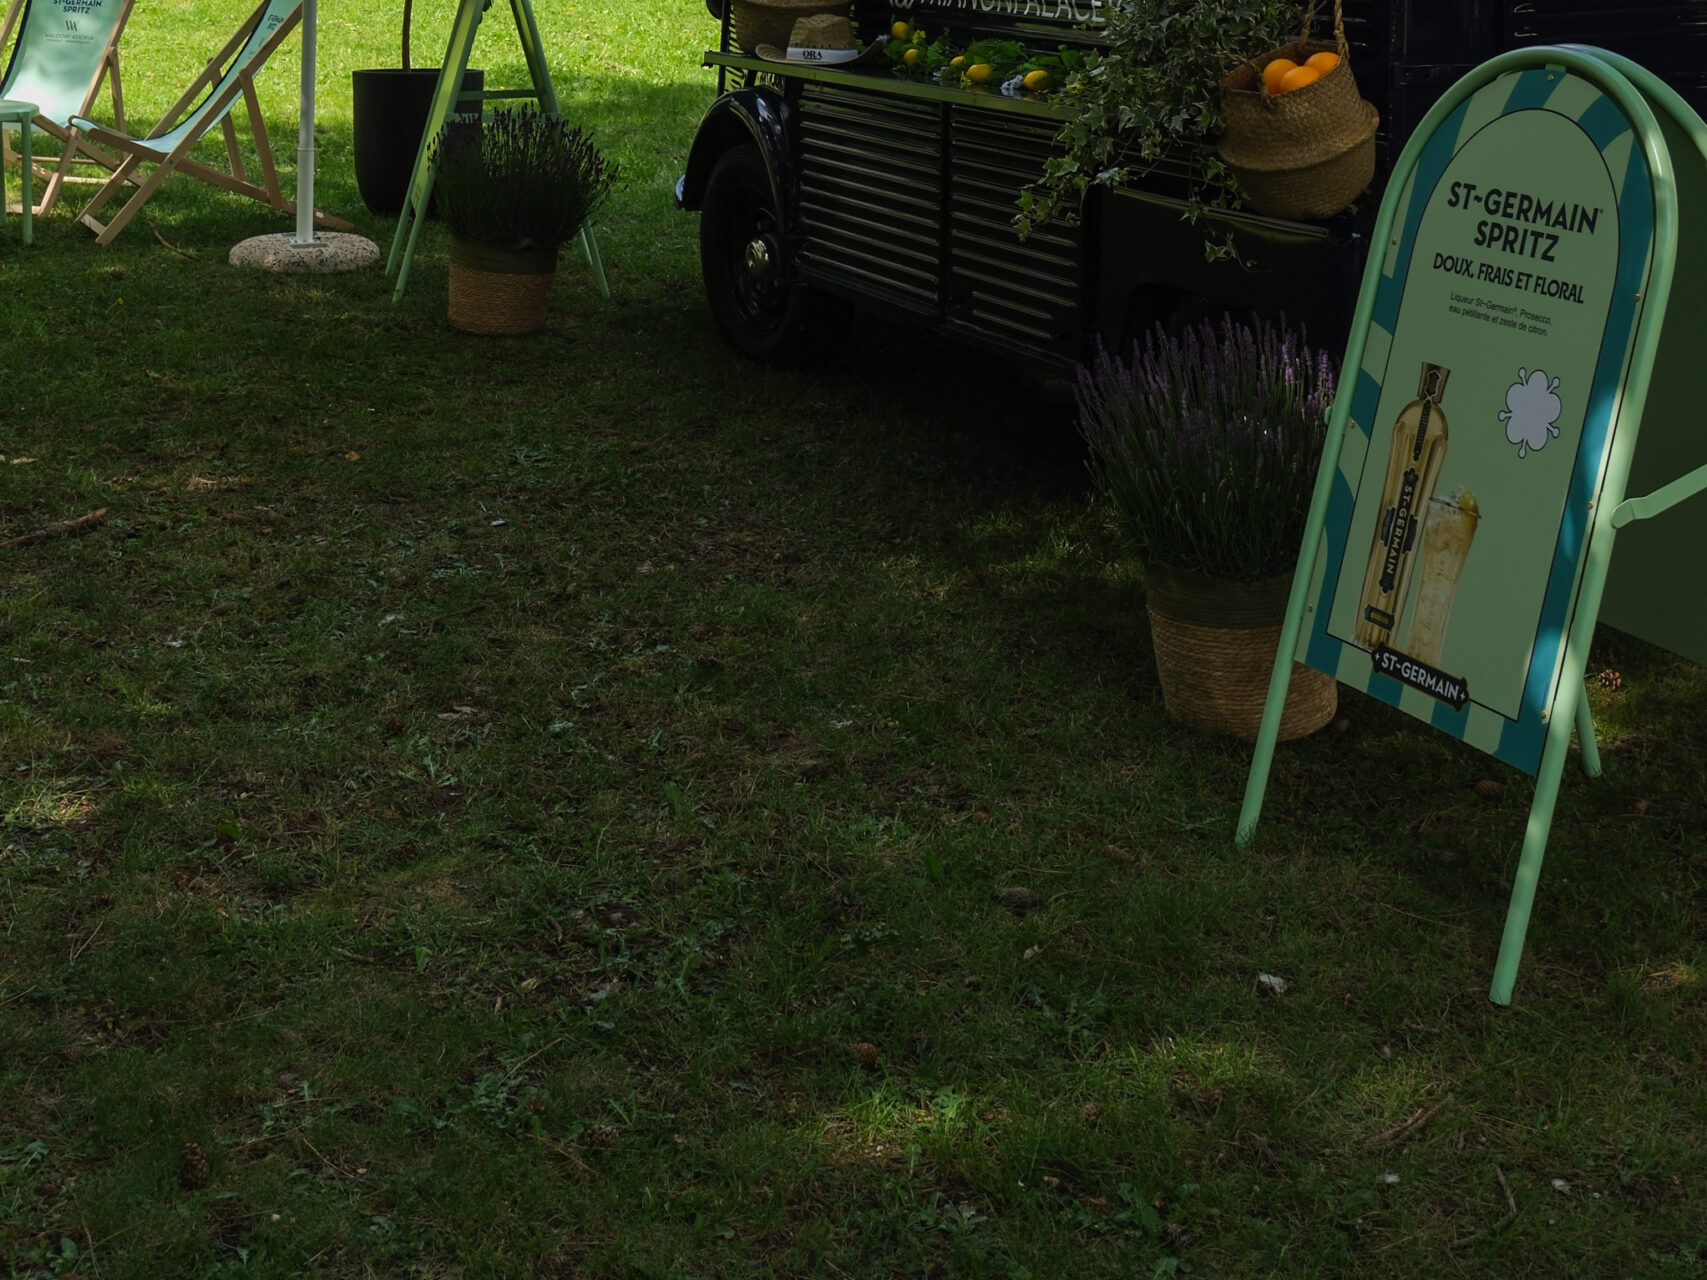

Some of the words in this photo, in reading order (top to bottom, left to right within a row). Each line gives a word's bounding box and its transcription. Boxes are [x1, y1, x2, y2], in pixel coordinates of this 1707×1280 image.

[63, 6, 91, 14] SPRITZ
[802, 49, 823, 59] ORA
[1473, 220, 1560, 262] SPRITZ
[1450, 291, 1474, 304] Liqueur
[1477, 263, 1514, 286] FRAIS
[1515, 271, 1533, 291] ET
[1533, 277, 1584, 304] FLORAL
[1491, 315, 1499, 323] et
[1499, 317, 1517, 329] zeste
[1518, 322, 1527, 331] de
[1386, 484, 1412, 575] ST-GERMAIN
[1381, 652, 1459, 701] ST-GERMAIN
